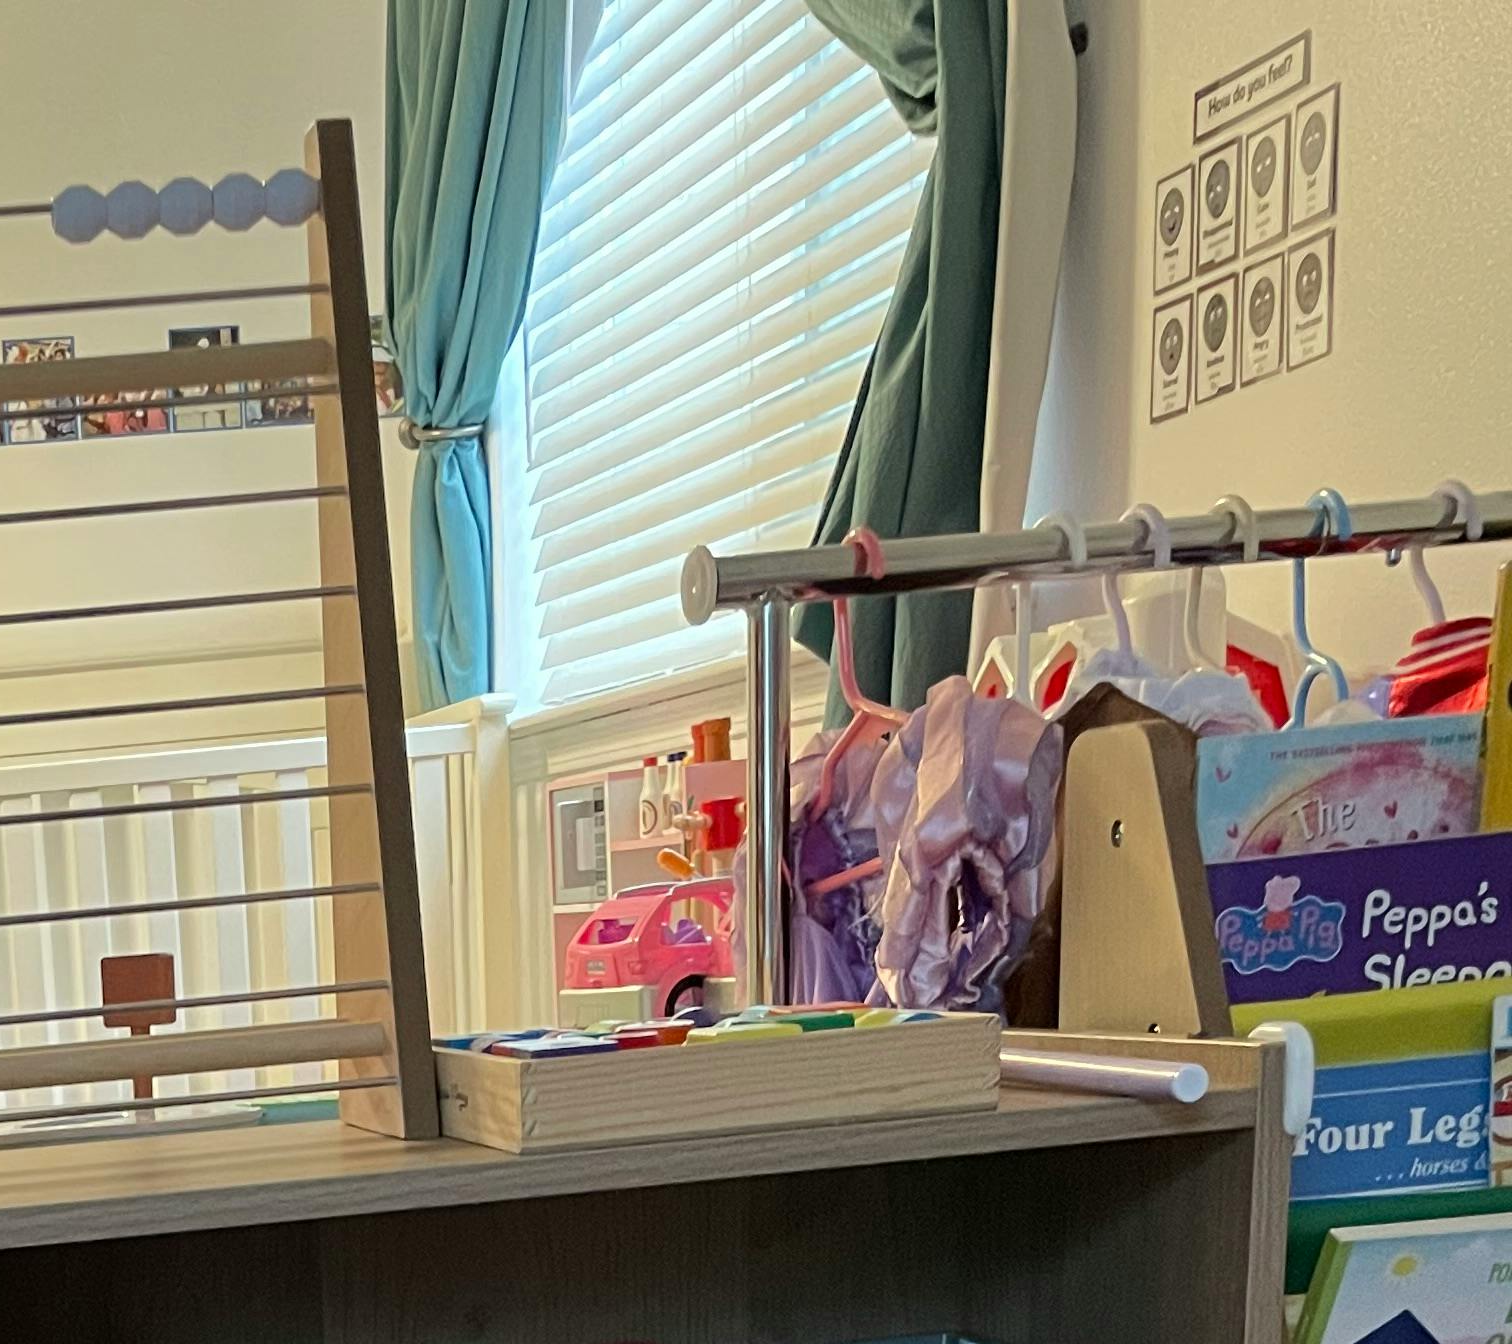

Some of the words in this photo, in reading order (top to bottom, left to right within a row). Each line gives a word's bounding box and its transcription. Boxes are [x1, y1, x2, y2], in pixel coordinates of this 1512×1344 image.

[1208, 94, 1231, 118] How
[1232, 84, 1246, 104] do
[1247, 74, 1266, 103] you
[1291, 797, 1356, 842] The
[1218, 913, 1296, 967] Peppa
[1299, 904, 1338, 949] Pig
[1362, 880, 1499, 950] Peppa's
[1291, 1117, 1395, 1157] Four
[1409, 1157, 1469, 1179] horses
[1488, 1262, 1512, 1283] PO
